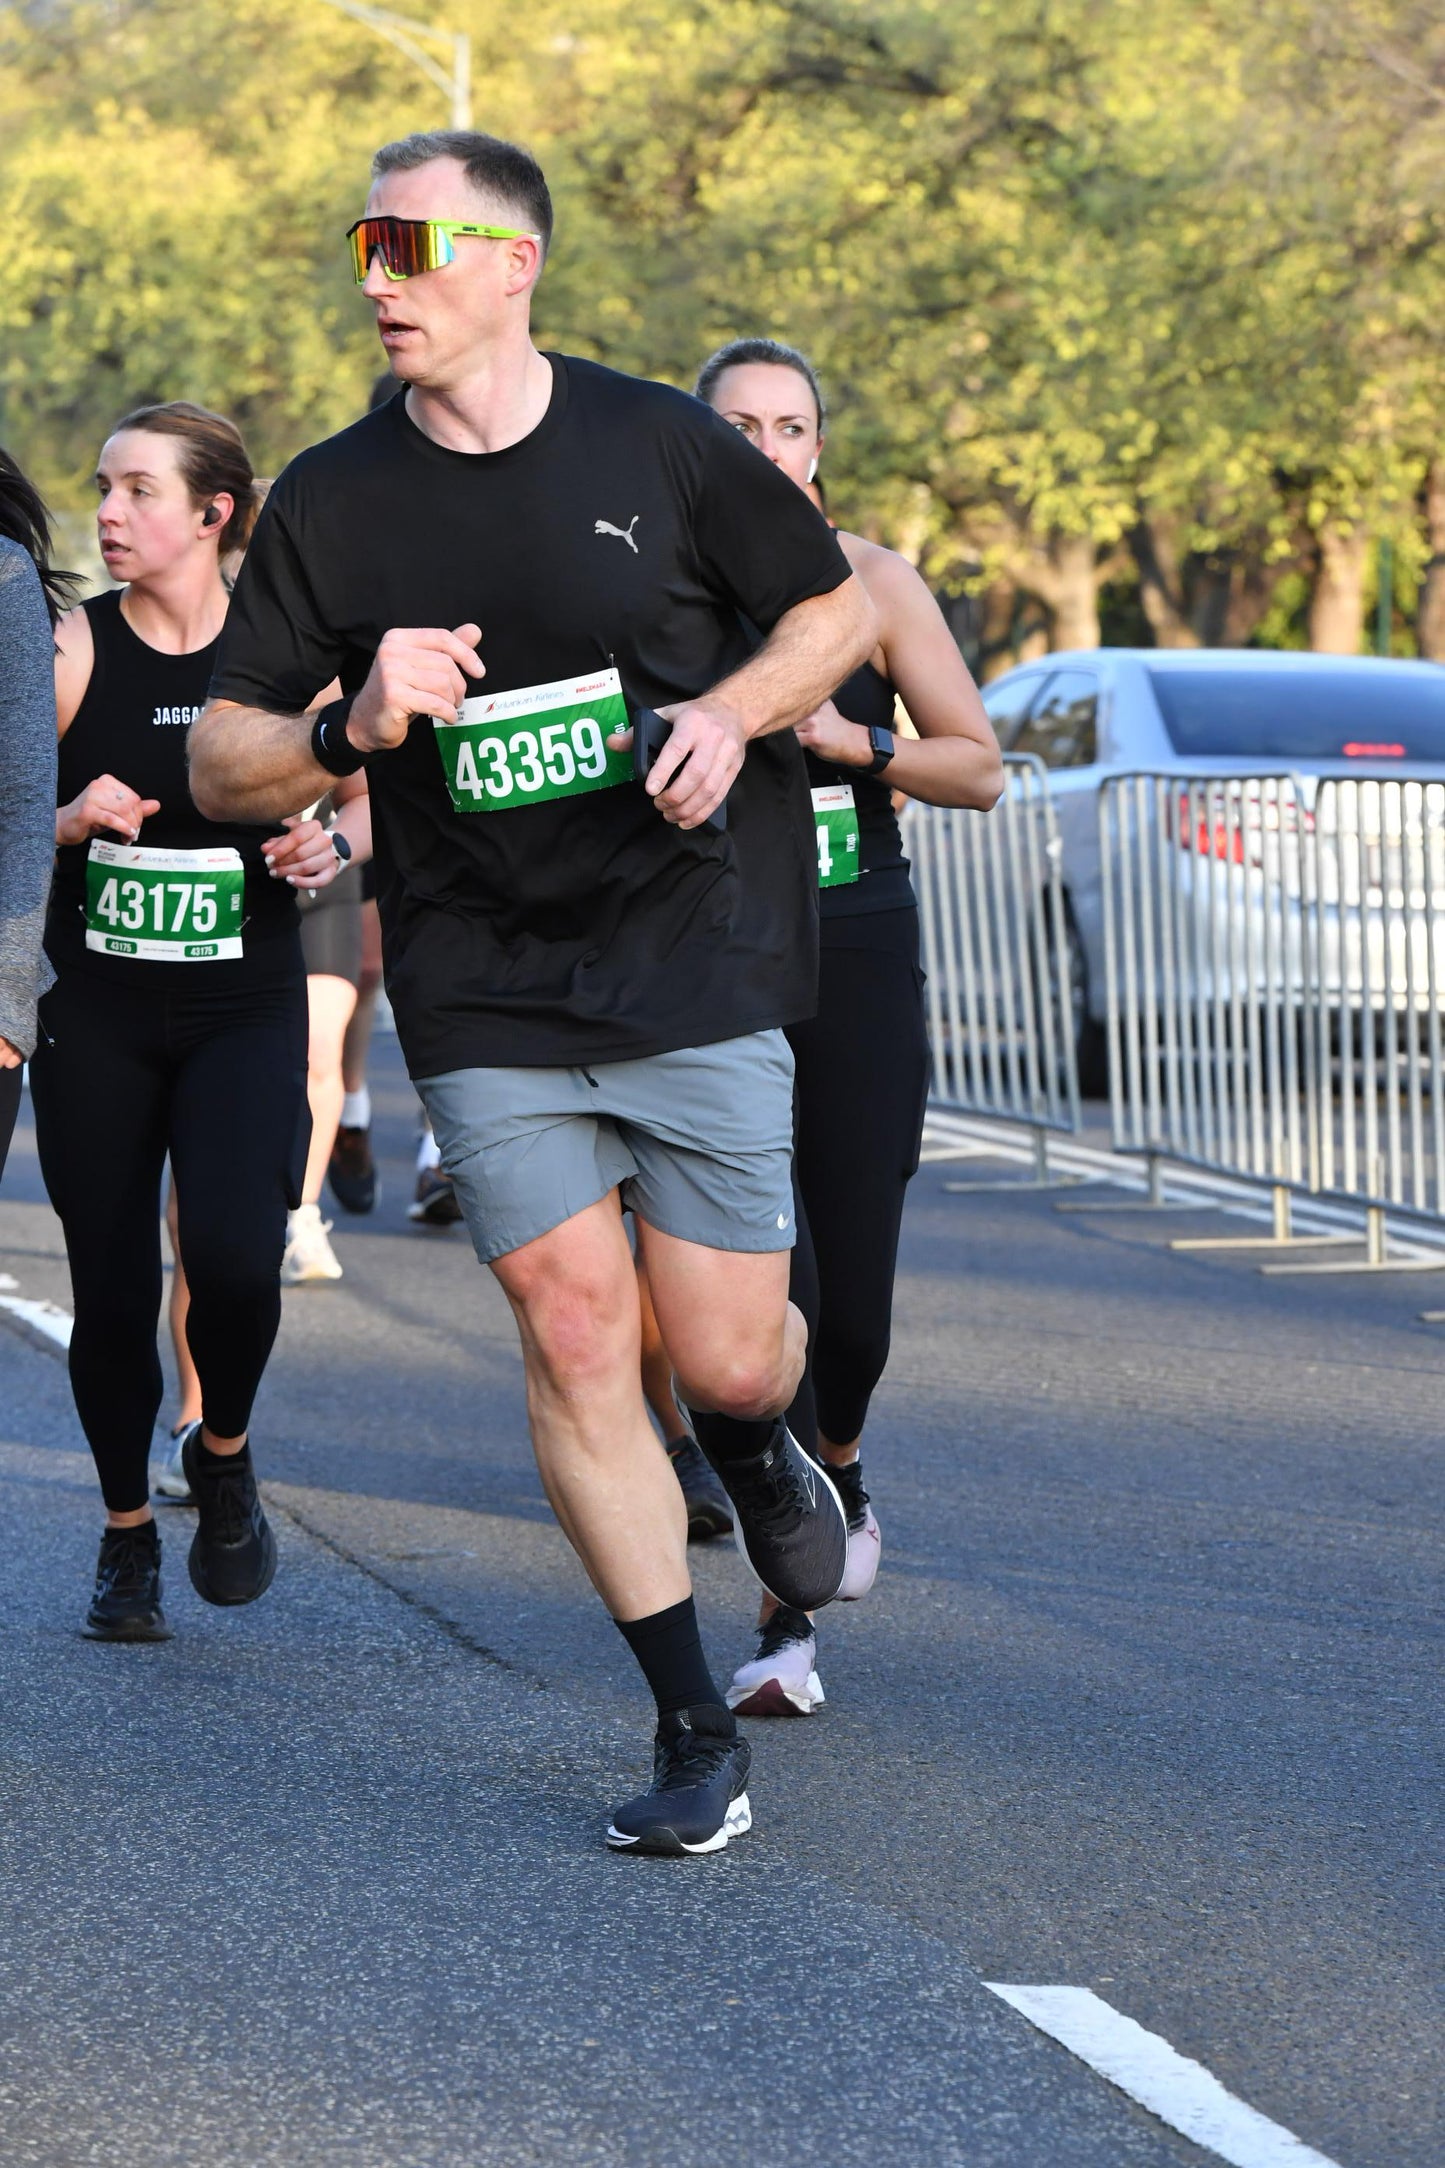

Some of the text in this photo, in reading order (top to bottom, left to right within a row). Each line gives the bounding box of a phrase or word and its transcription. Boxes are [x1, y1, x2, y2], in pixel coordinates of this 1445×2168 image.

[153, 706, 206, 725] JAGGA
[614, 722, 626, 734] 10
[455, 718, 608, 800] 43359
[816, 825, 833, 877] 4
[96, 877, 218, 933] 43175
[110, 940, 132, 953] 43175
[190, 945, 213, 956] 43175
